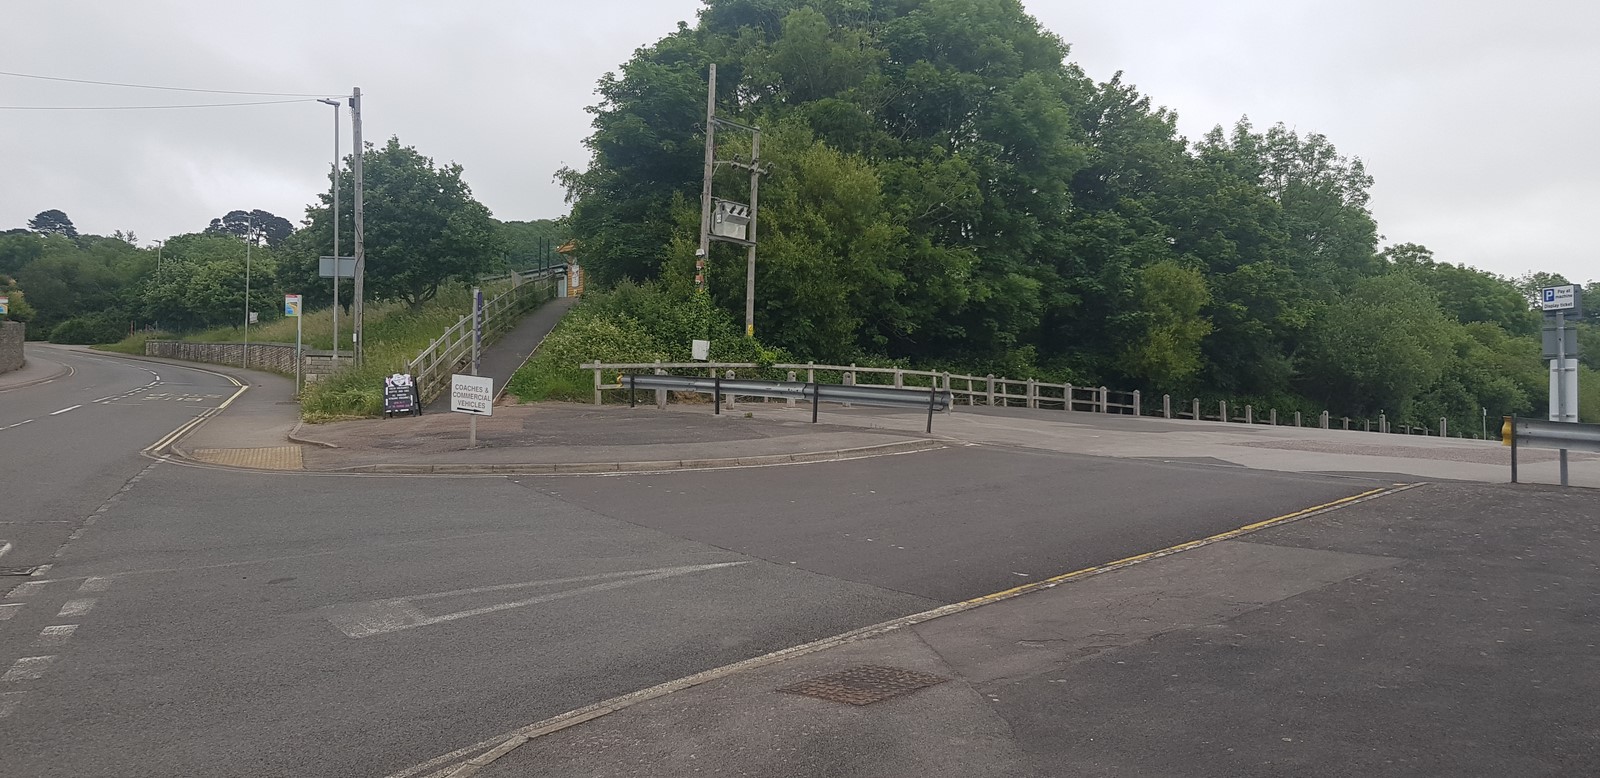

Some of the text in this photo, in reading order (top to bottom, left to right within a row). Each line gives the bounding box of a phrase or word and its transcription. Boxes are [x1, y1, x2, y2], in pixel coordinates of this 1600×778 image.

[1546, 291, 1553, 300] P
[455, 384, 483, 392] COACHES
[453, 392, 491, 401] COMMERCIAL
[458, 400, 486, 409] VEHICLES
